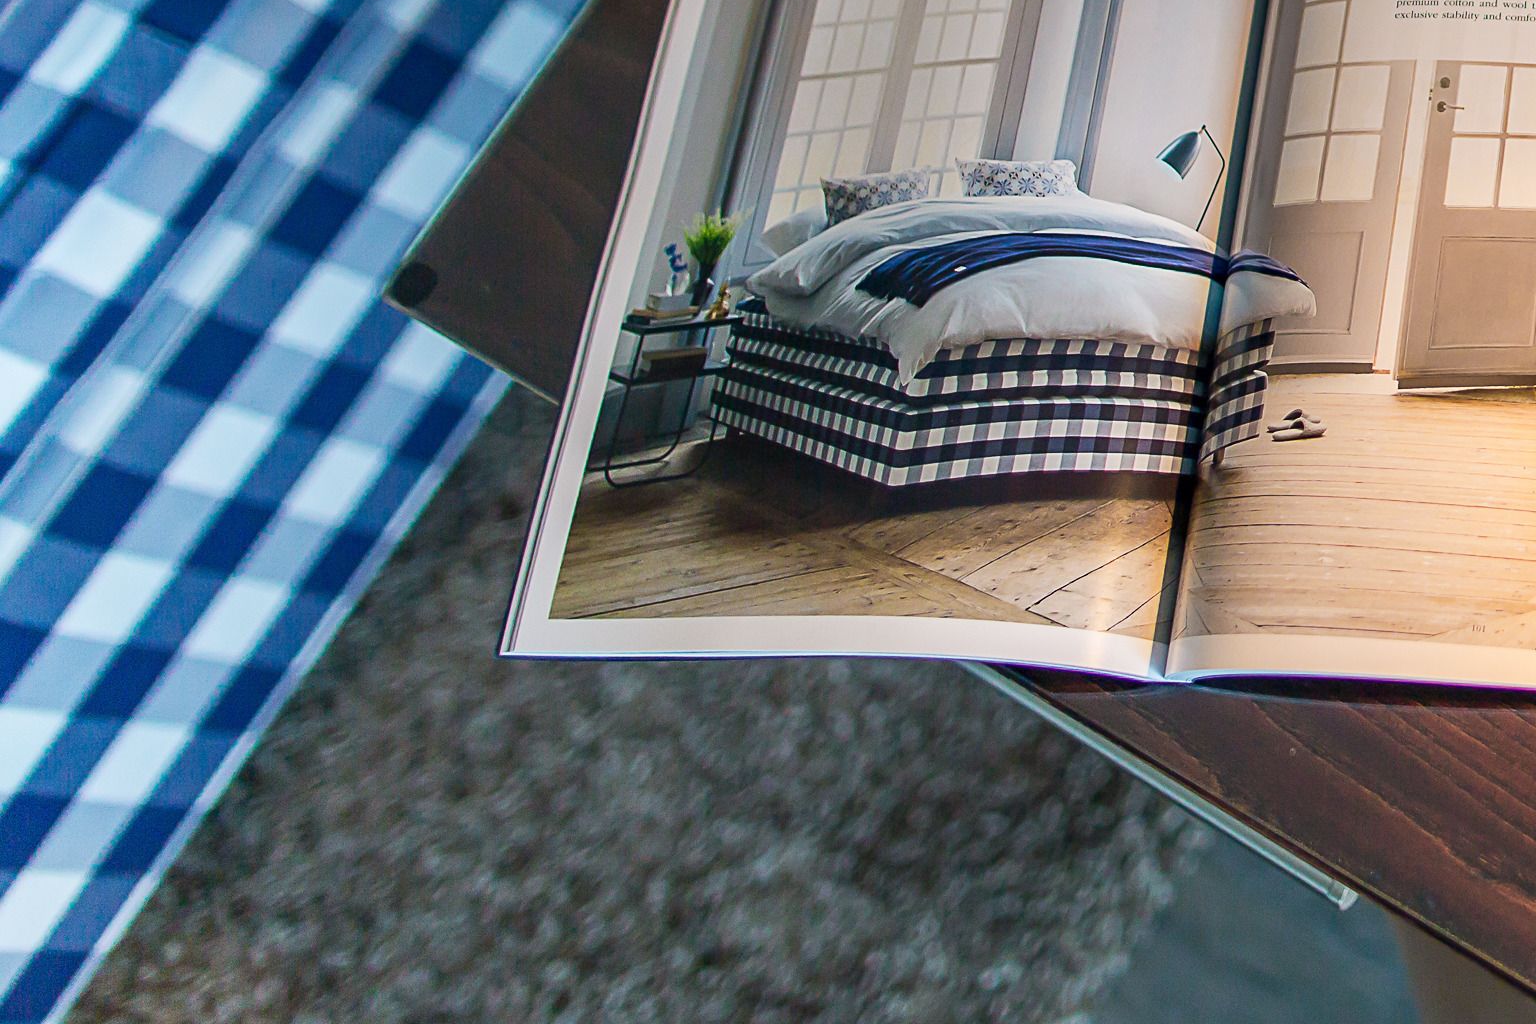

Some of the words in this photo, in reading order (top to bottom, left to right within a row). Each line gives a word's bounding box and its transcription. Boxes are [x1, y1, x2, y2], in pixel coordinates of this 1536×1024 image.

[1395, 0, 1439, 8] premium
[1502, 0, 1527, 9] wool
[1441, 11, 1479, 21] stability
[1483, 12, 1502, 20] and
